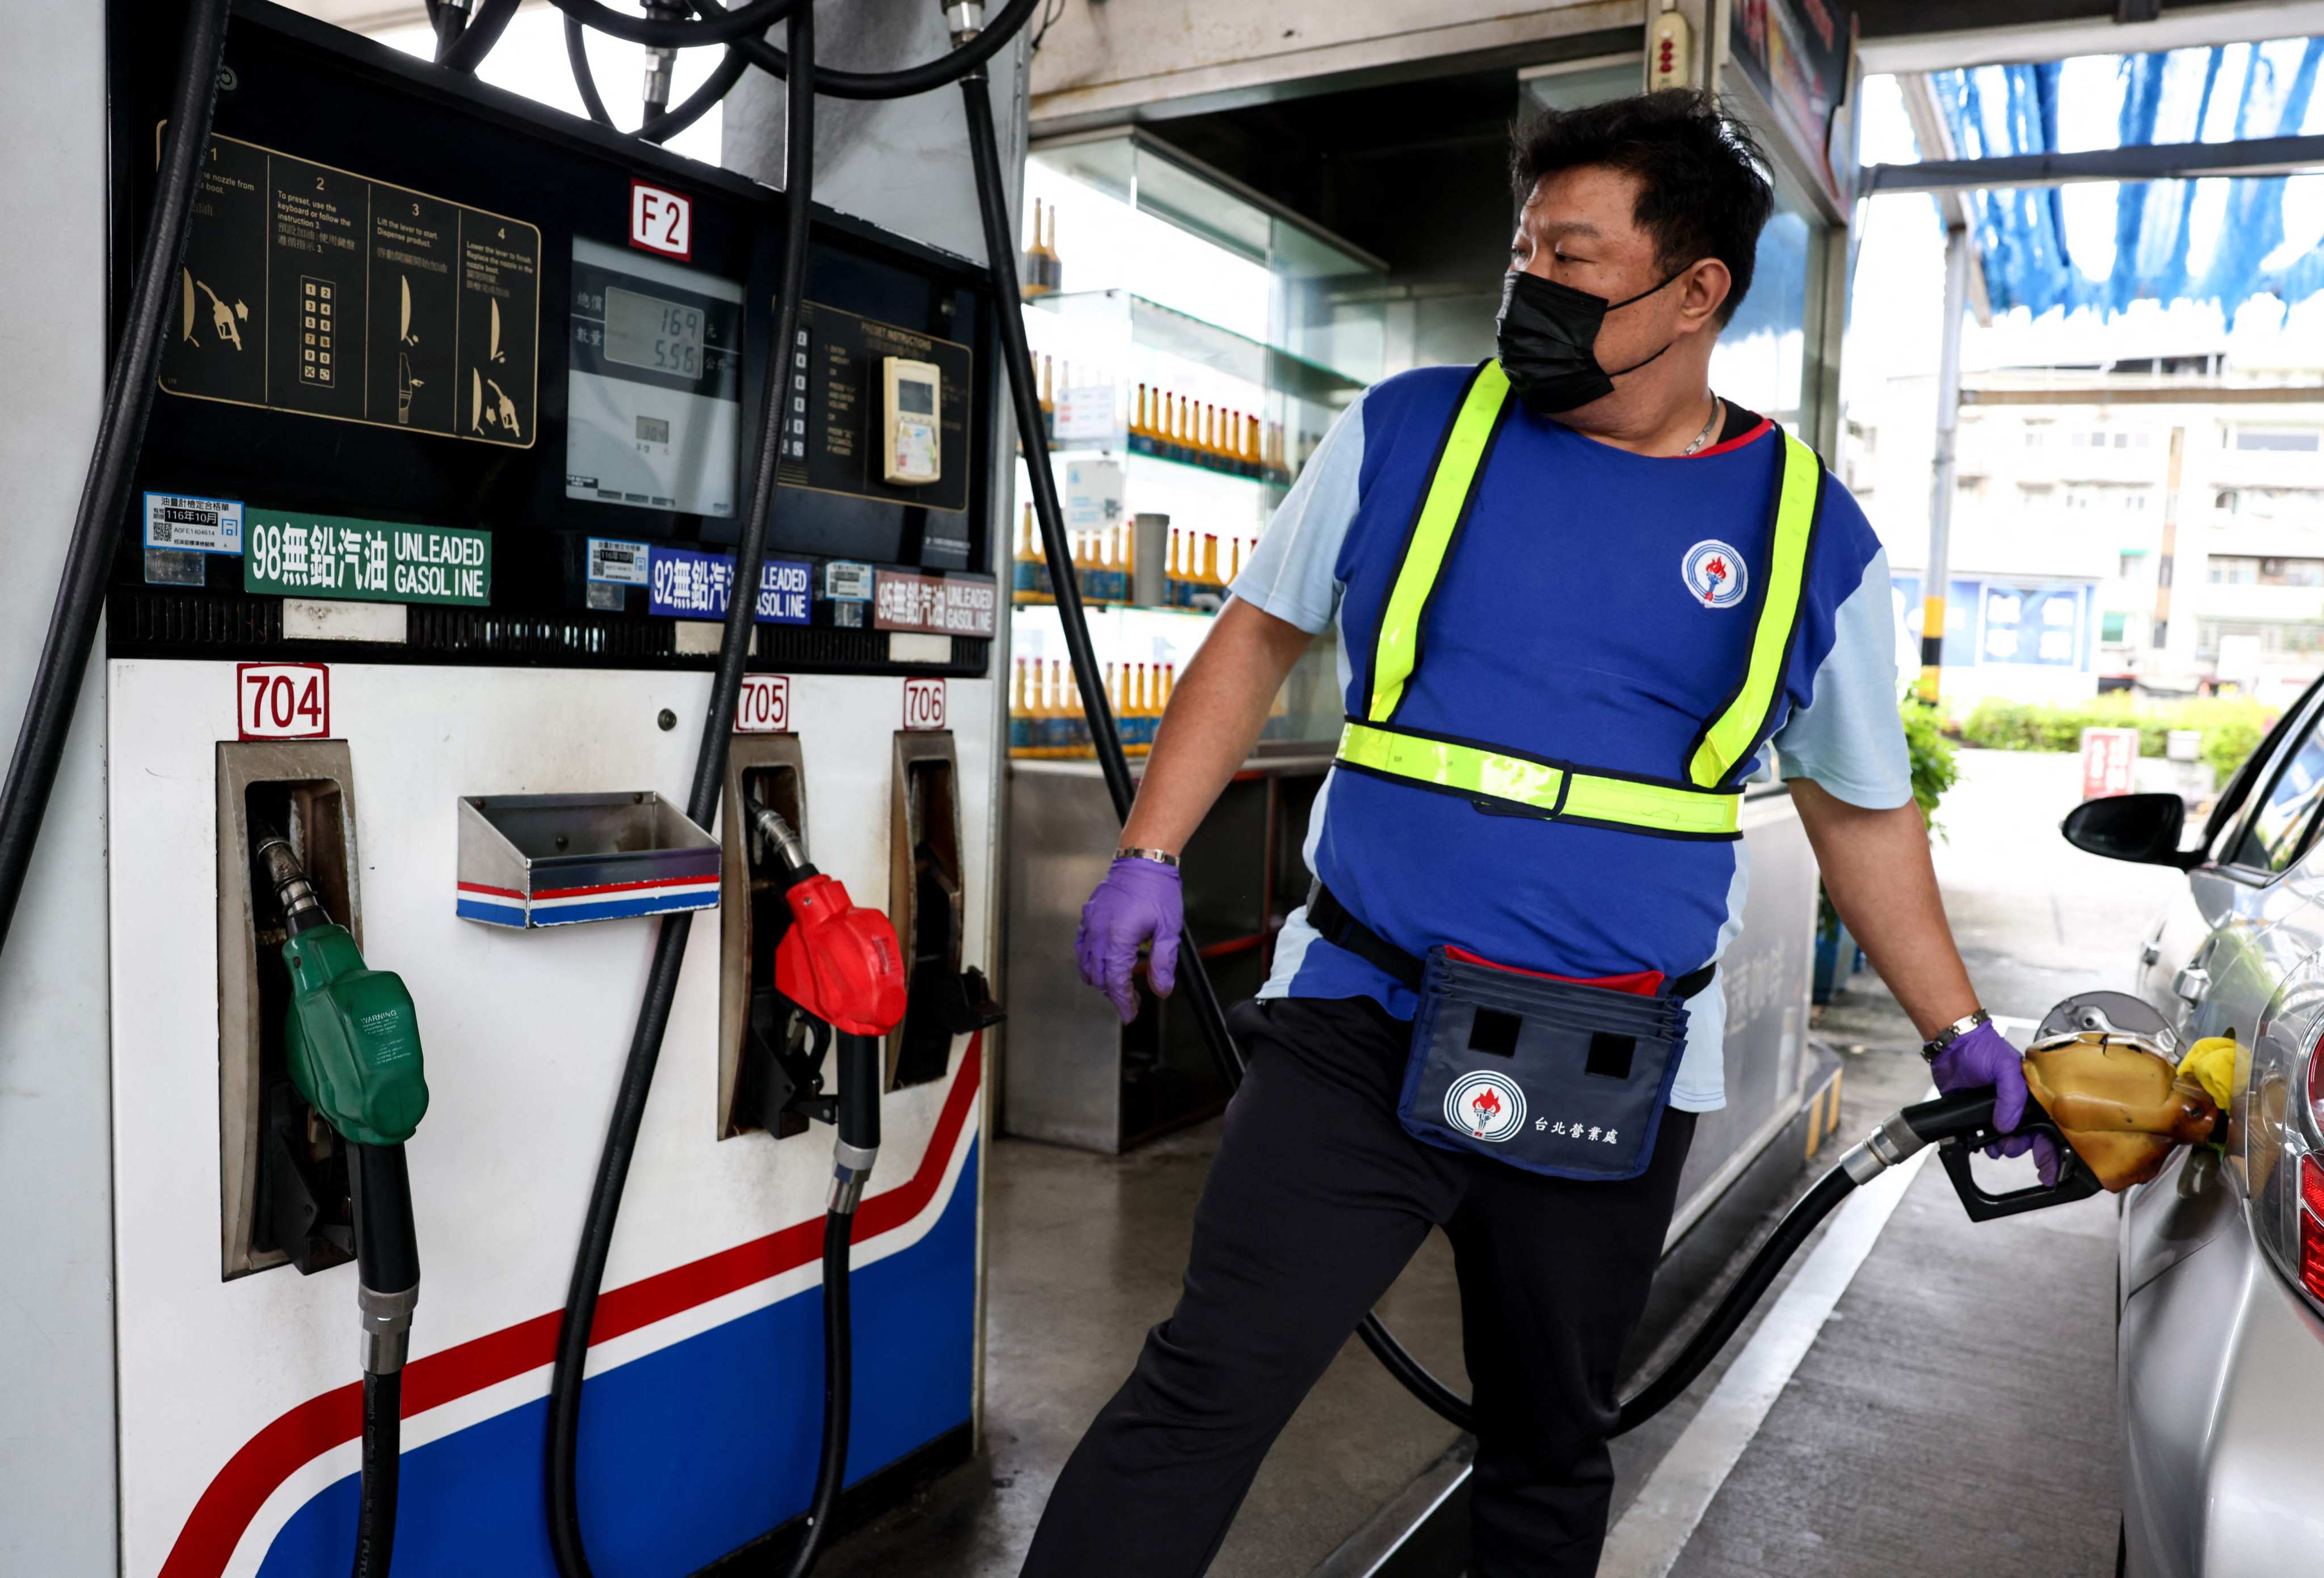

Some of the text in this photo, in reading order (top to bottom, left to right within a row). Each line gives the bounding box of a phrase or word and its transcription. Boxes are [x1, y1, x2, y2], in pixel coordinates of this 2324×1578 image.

[210, 147, 217, 161] 1
[206, 183, 225, 193] boot.
[213, 174, 235, 185] nozzle
[238, 180, 254, 191] from
[316, 177, 325, 190] 2
[277, 190, 286, 199] To
[326, 204, 336, 213] the
[412, 204, 419, 216] 3
[277, 201, 309, 216] keyboard
[319, 212, 339, 223] follow
[340, 218, 351, 227] the
[277, 212, 314, 227] instruction
[377, 217, 388, 226] Lift
[389, 220, 399, 229] the
[400, 223, 415, 233] lever
[377, 227, 405, 241] Dispense
[498, 227, 505, 239] 4
[661, 308, 697, 339] 169
[166, 510, 217, 524] 116年10月
[253, 522, 388, 591] 98無鉛汽油
[394, 531, 485, 566] UNLEADED
[394, 564, 483, 597] GASOLINE
[759, 566, 807, 592] LEADED
[756, 592, 806, 618] ASOLINE
[878, 580, 945, 627] 95無鉛汽油
[946, 585, 992, 609] UNLEADED
[247, 676, 321, 728] 704
[742, 684, 784, 723] 705
[909, 687, 941, 721] 706
[361, 1010, 397, 1024] WARNING
[1535, 1116, 1618, 1144] 台北營業處
